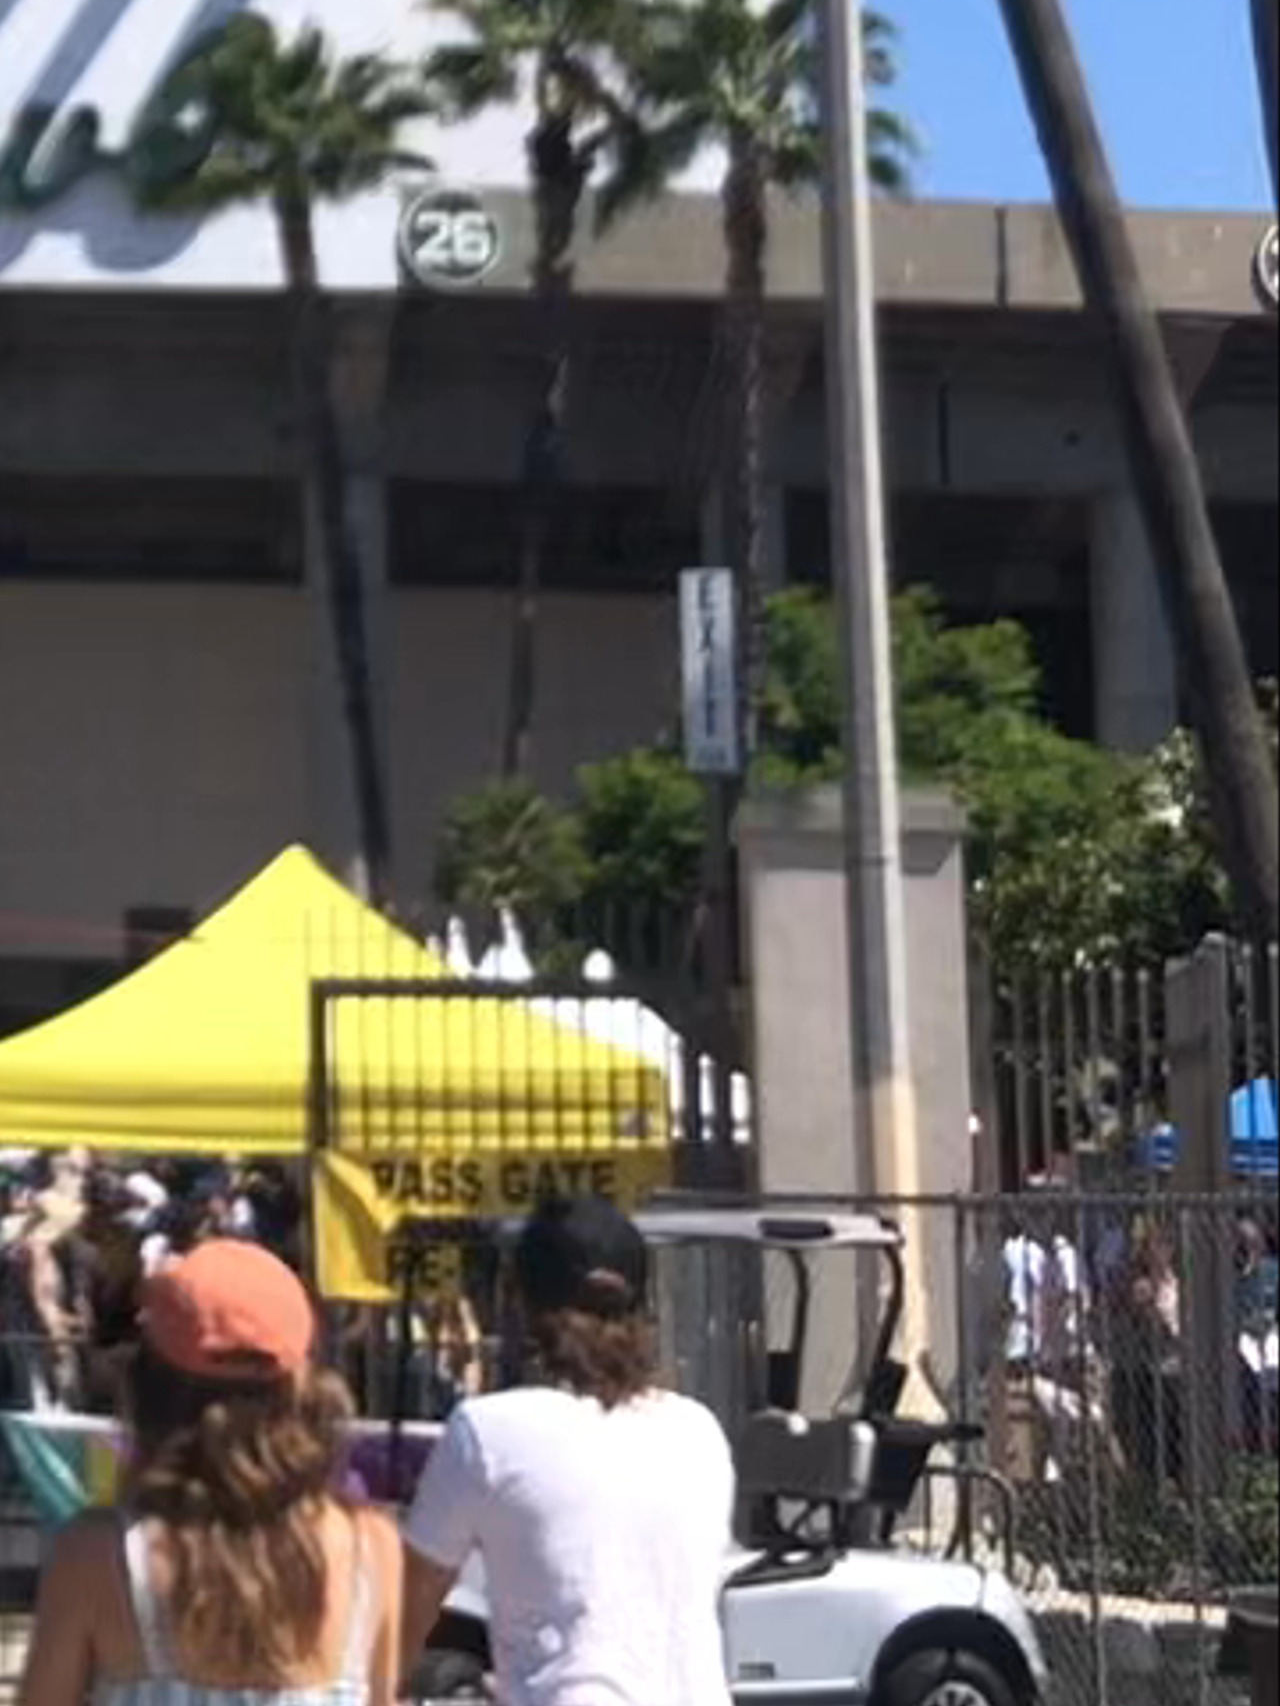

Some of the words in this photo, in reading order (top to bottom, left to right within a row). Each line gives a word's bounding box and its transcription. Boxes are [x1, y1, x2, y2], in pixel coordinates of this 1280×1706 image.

[414, 211, 490, 264] 26
[372, 1160, 482, 1207] PASS
[500, 1160, 618, 1204] GATE
